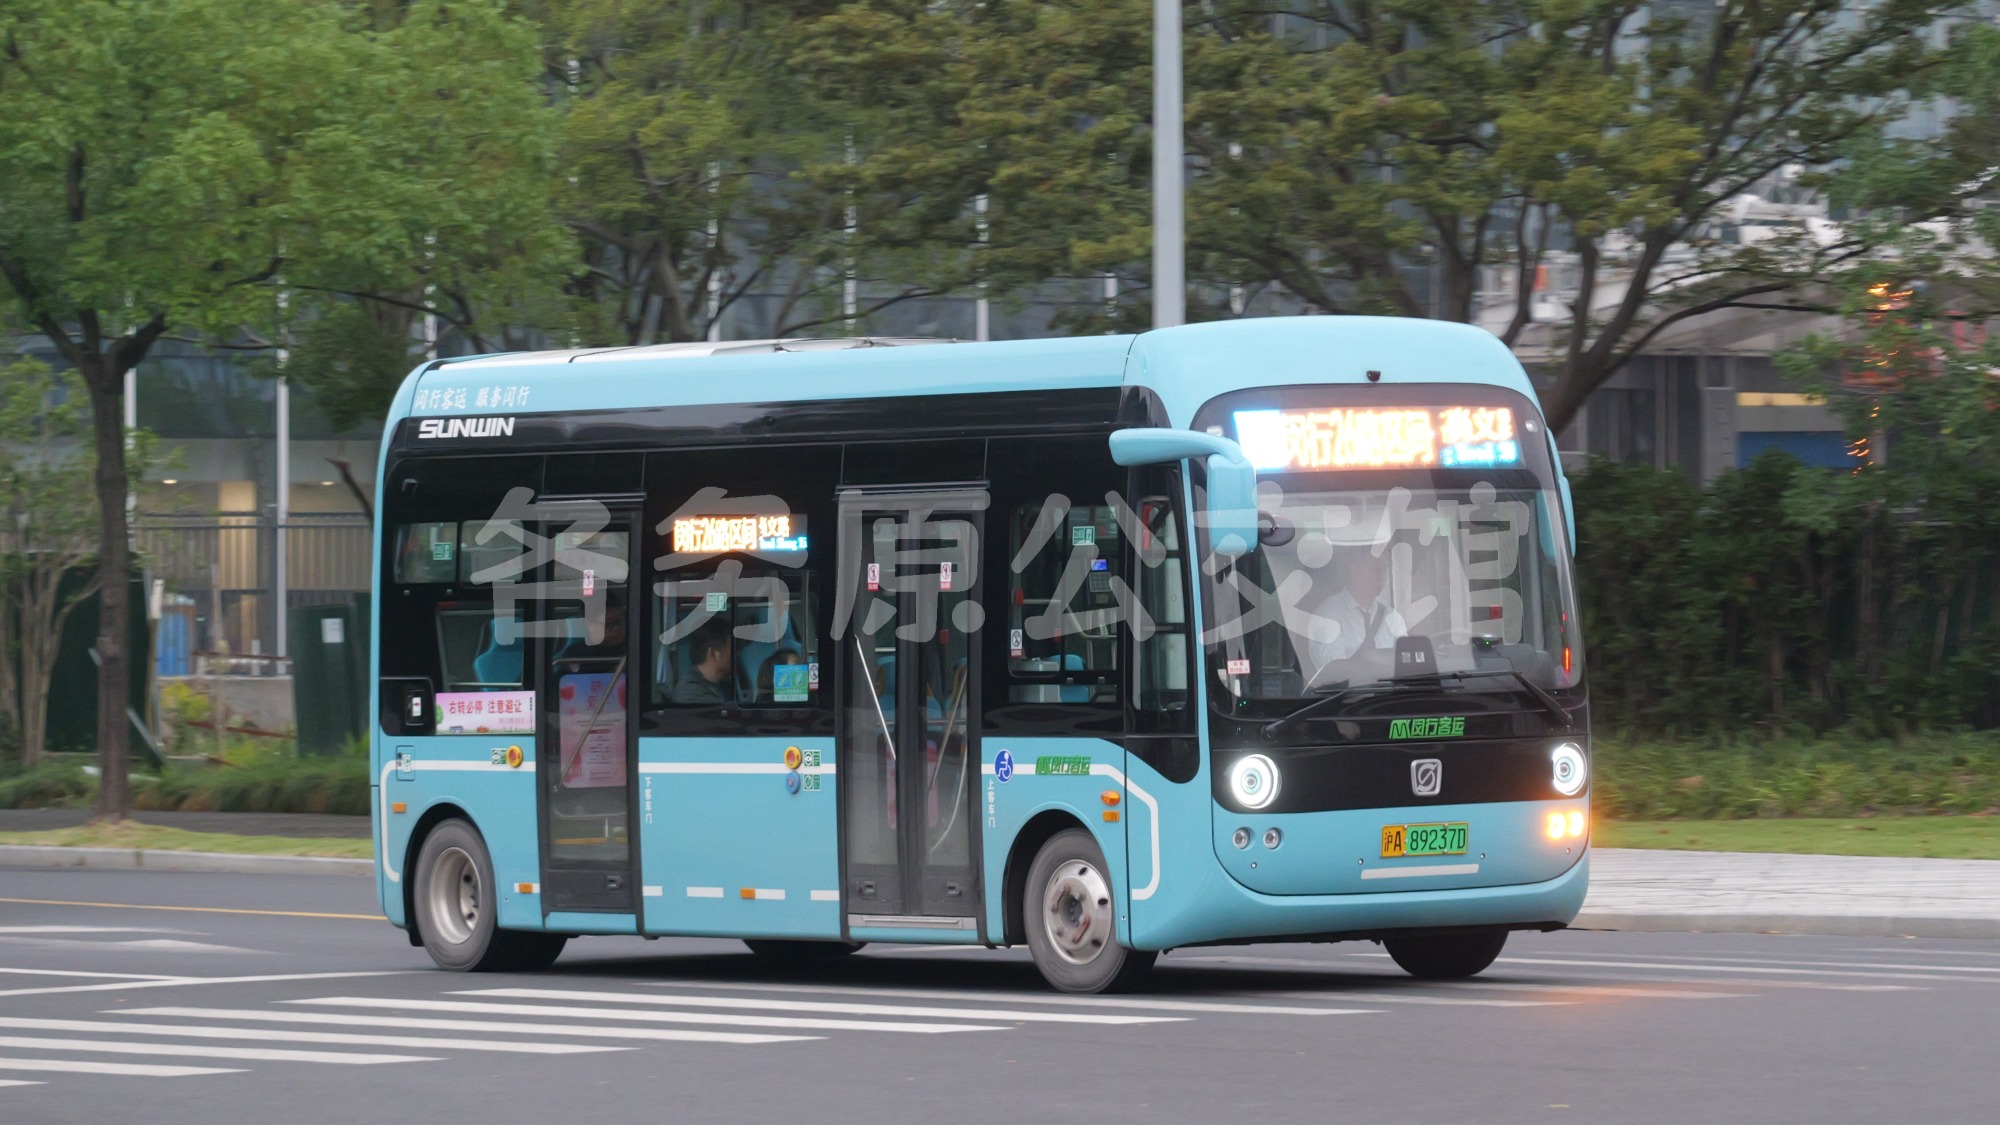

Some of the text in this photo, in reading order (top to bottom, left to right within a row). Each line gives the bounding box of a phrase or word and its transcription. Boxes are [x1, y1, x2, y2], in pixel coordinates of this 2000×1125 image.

[414, 386, 530, 410] 闵行客运 服务闵行
[418, 417, 515, 438] SUNWIN
[449, 701, 483, 714] 右转必停
[488, 700, 522, 713] 注意避让
[1411, 716, 1465, 737] 闵行客运
[987, 778, 996, 828] 上客车门
[1384, 827, 1467, 852] 沪A 89237D
